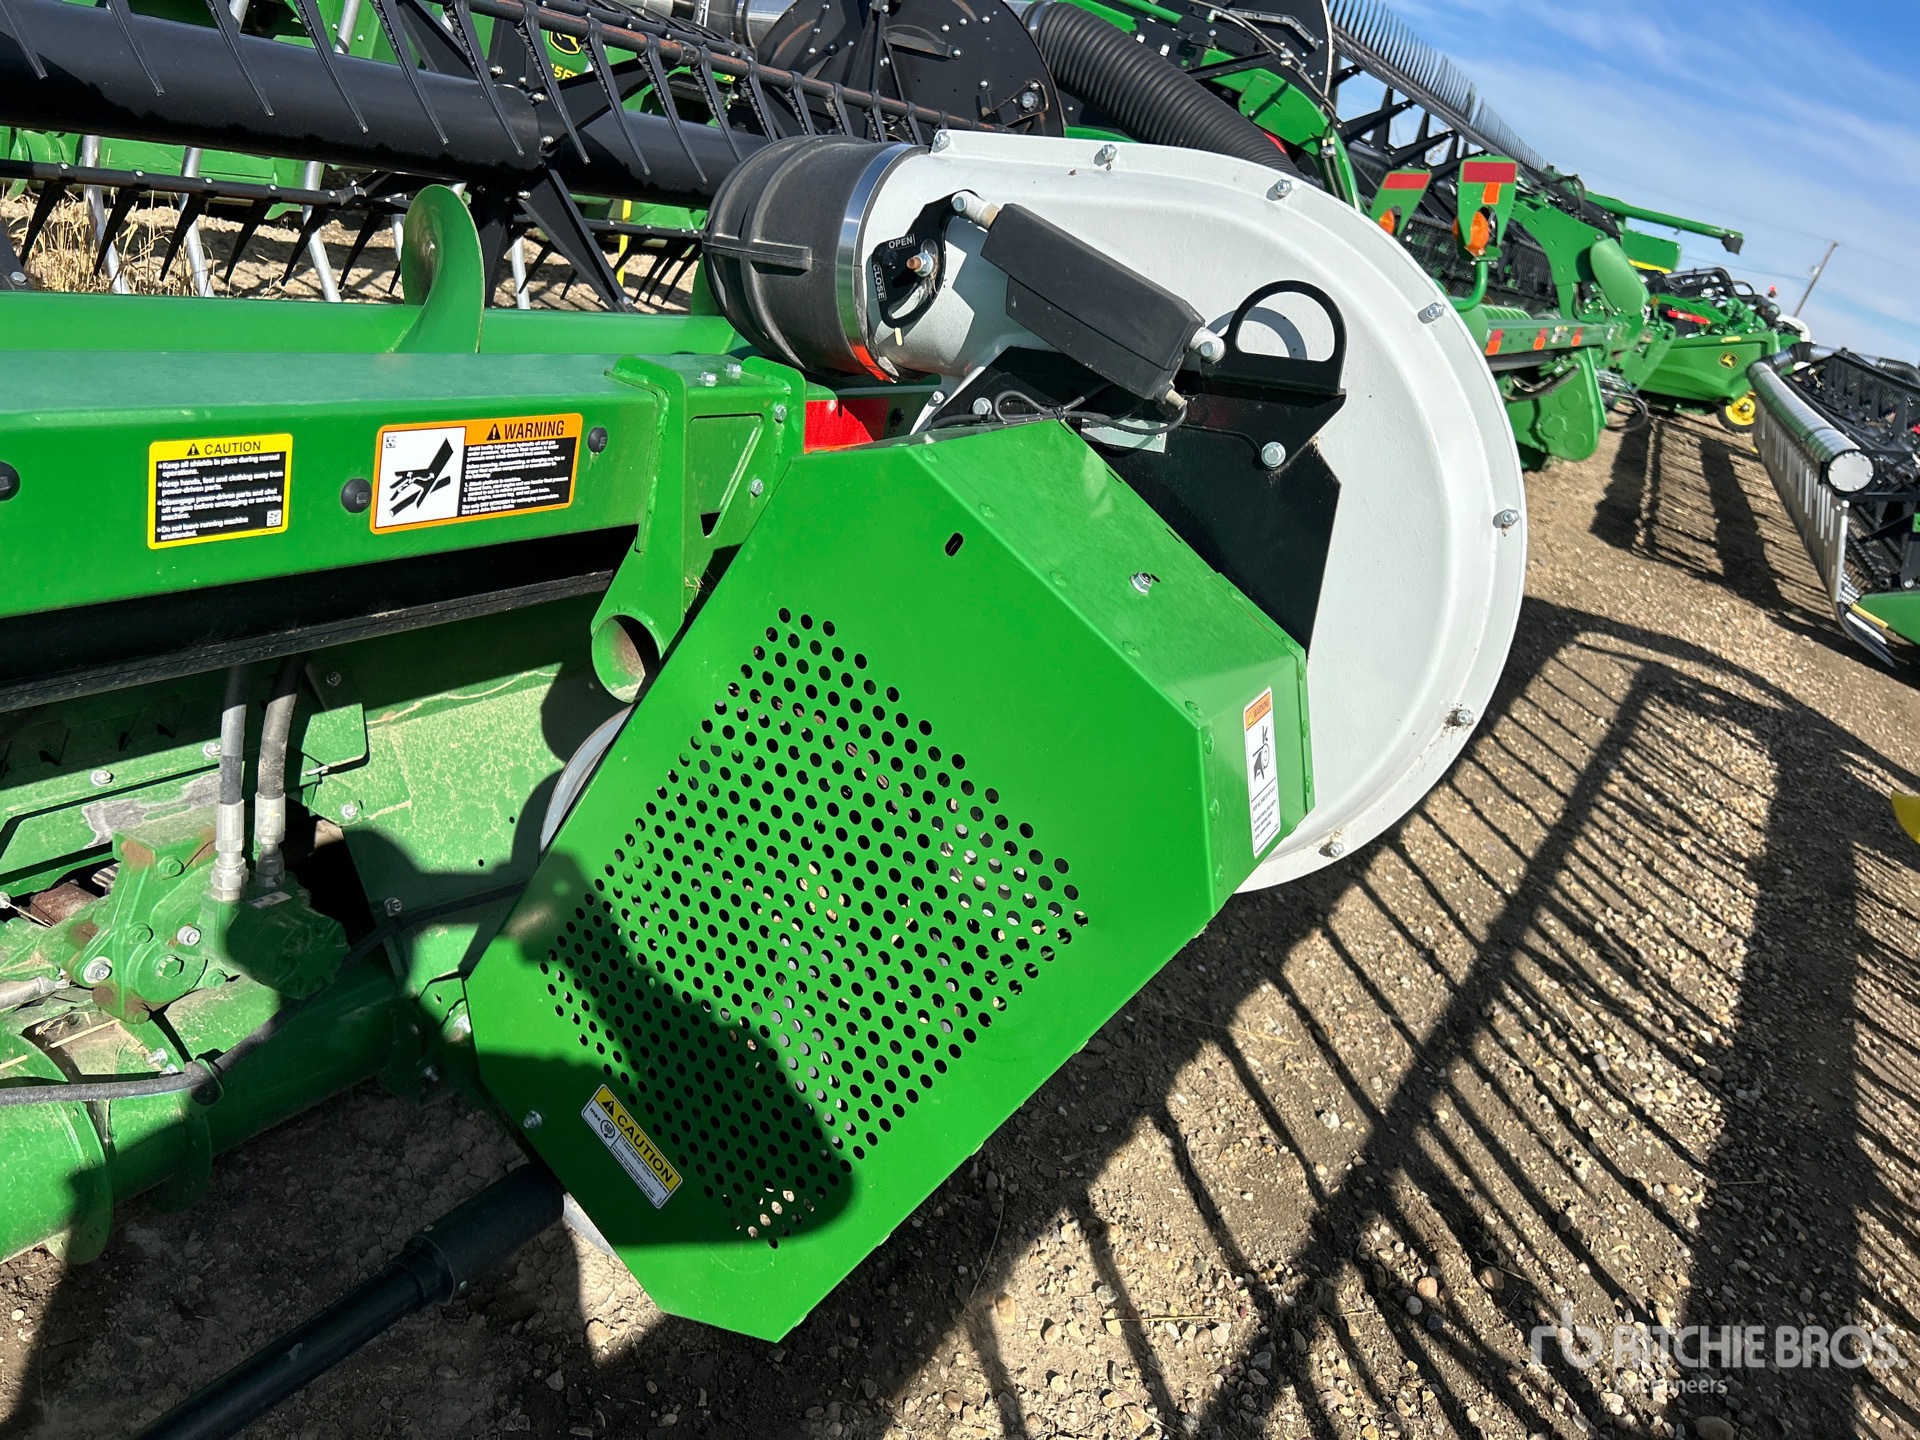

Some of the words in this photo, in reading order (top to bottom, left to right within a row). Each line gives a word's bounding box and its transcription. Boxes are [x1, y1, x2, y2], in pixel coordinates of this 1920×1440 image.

[888, 235, 913, 249] OPEN
[872, 263, 885, 300] CLOSE
[504, 420, 564, 440] WARNING
[204, 441, 262, 455] CAUTION
[617, 1114, 673, 1183] CAUTION
